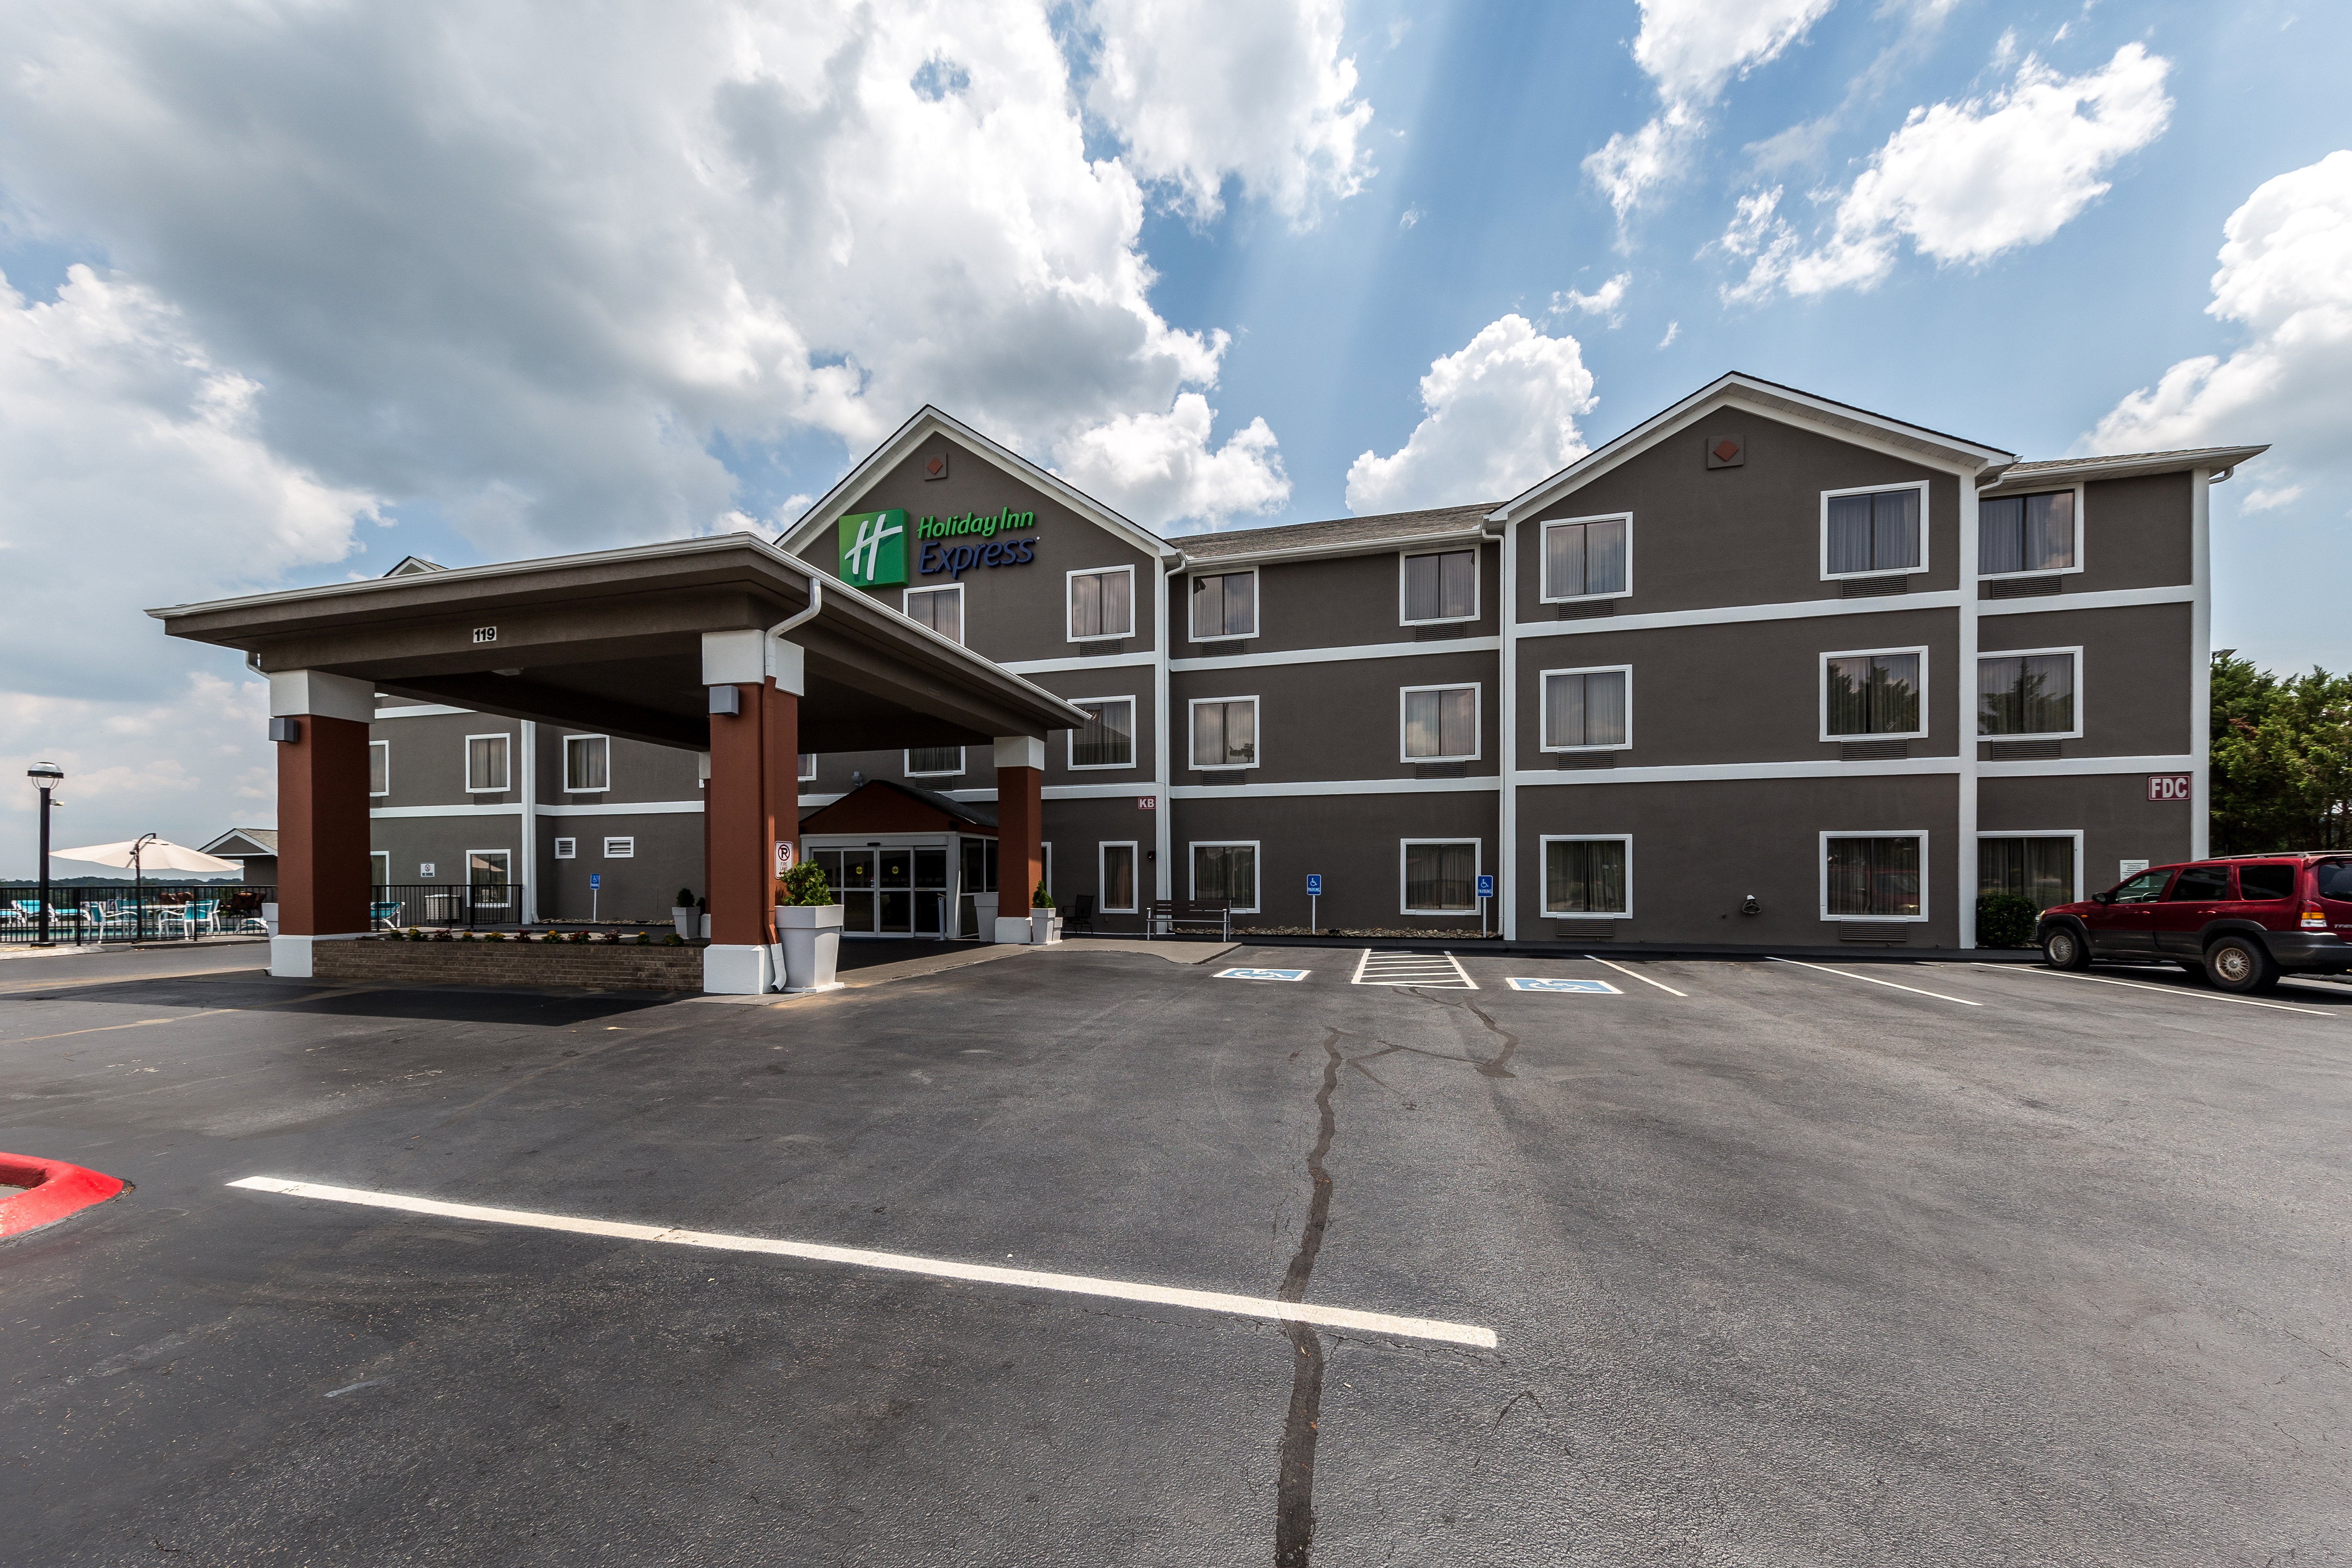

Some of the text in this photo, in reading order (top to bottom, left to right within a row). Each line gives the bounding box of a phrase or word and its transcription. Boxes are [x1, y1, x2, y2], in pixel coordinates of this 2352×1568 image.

[917, 506, 1035, 539] Holiday Inn
[918, 538, 1036, 579] Express
[475, 627, 495, 641] 119
[2151, 778, 2187, 798] FDC
[1139, 799, 1155, 808] KB
